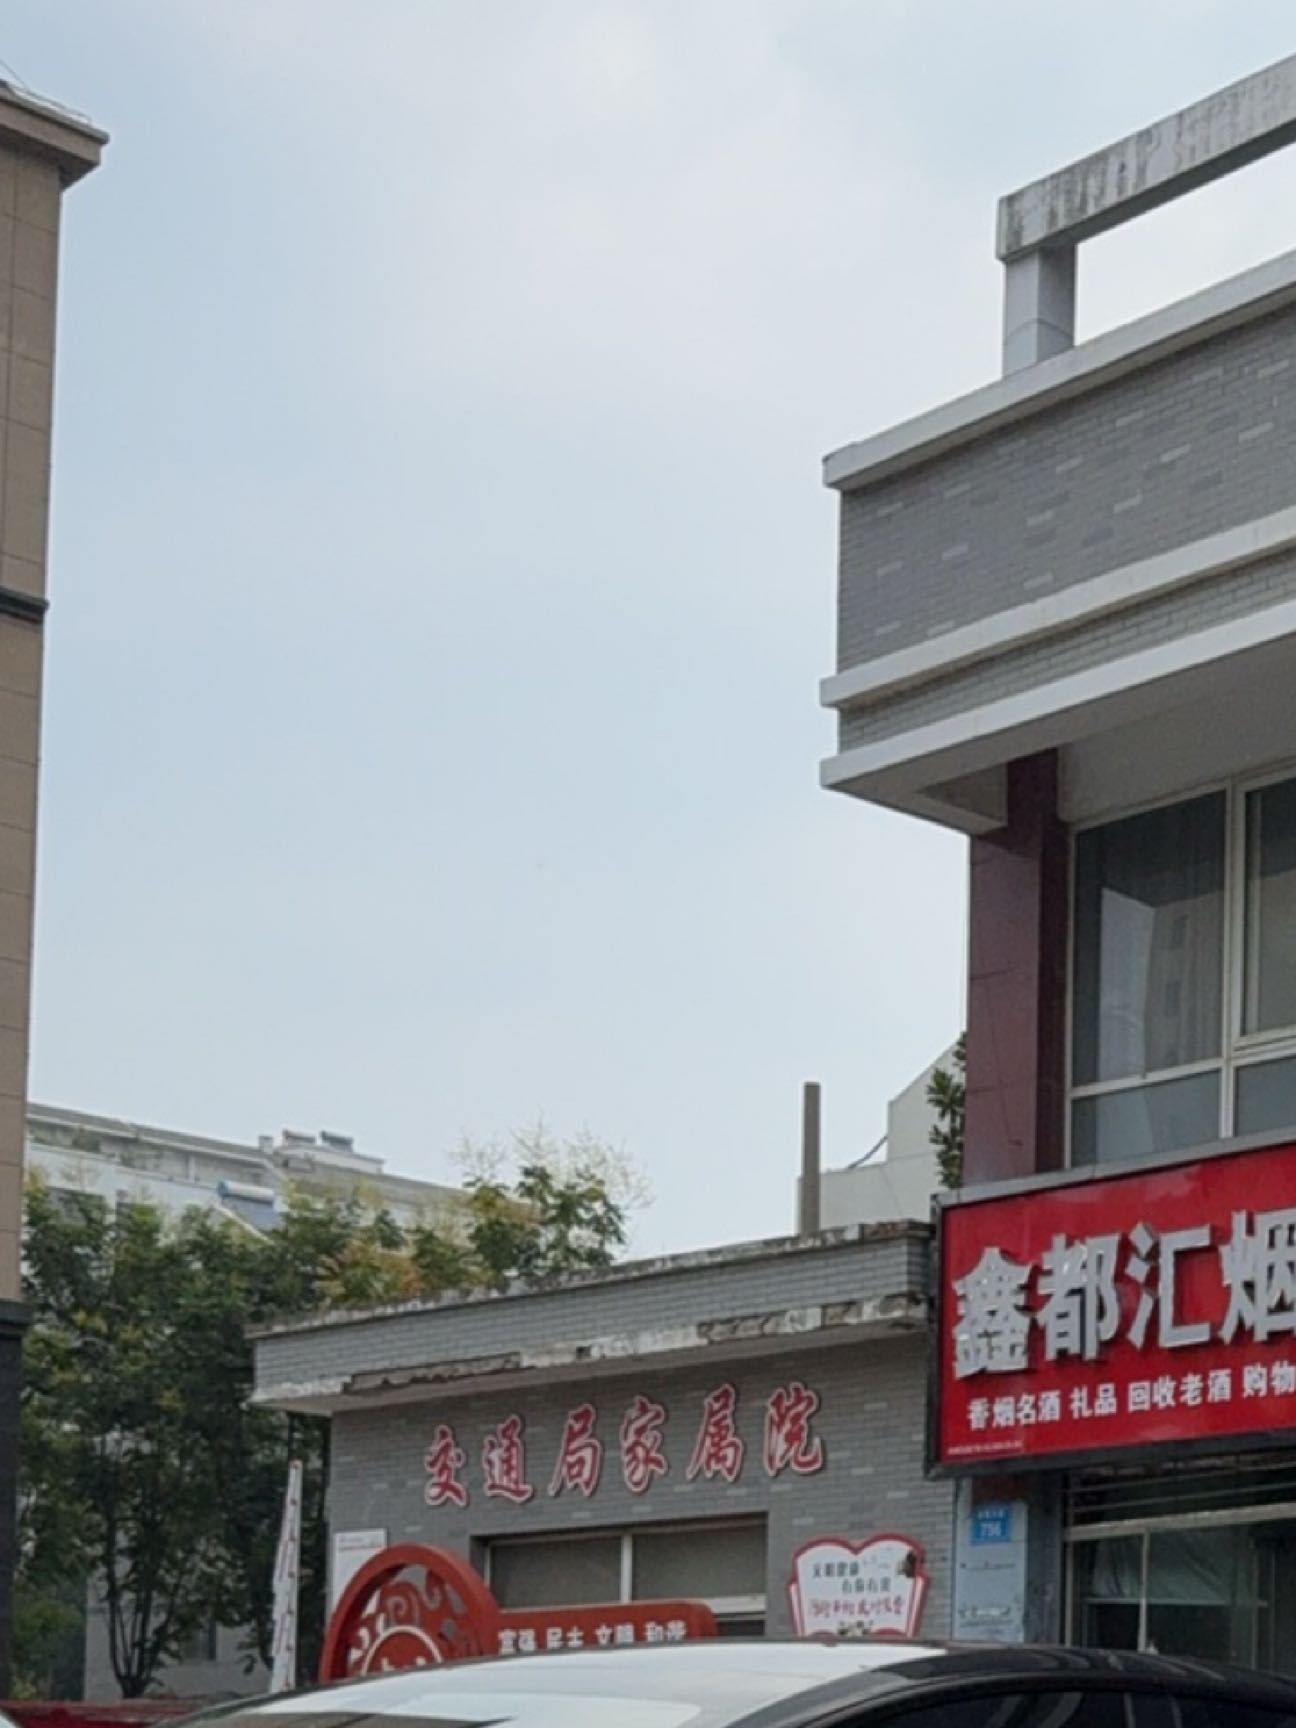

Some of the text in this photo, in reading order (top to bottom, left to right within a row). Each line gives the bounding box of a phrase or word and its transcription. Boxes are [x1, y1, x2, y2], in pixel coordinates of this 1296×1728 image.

[422, 1380, 826, 1508] 交通局家属院
[967, 1389, 1062, 1431] 香烟名酒
[1069, 1382, 1117, 1420] 礼品
[1128, 1368, 1232, 1413] 回收老酒
